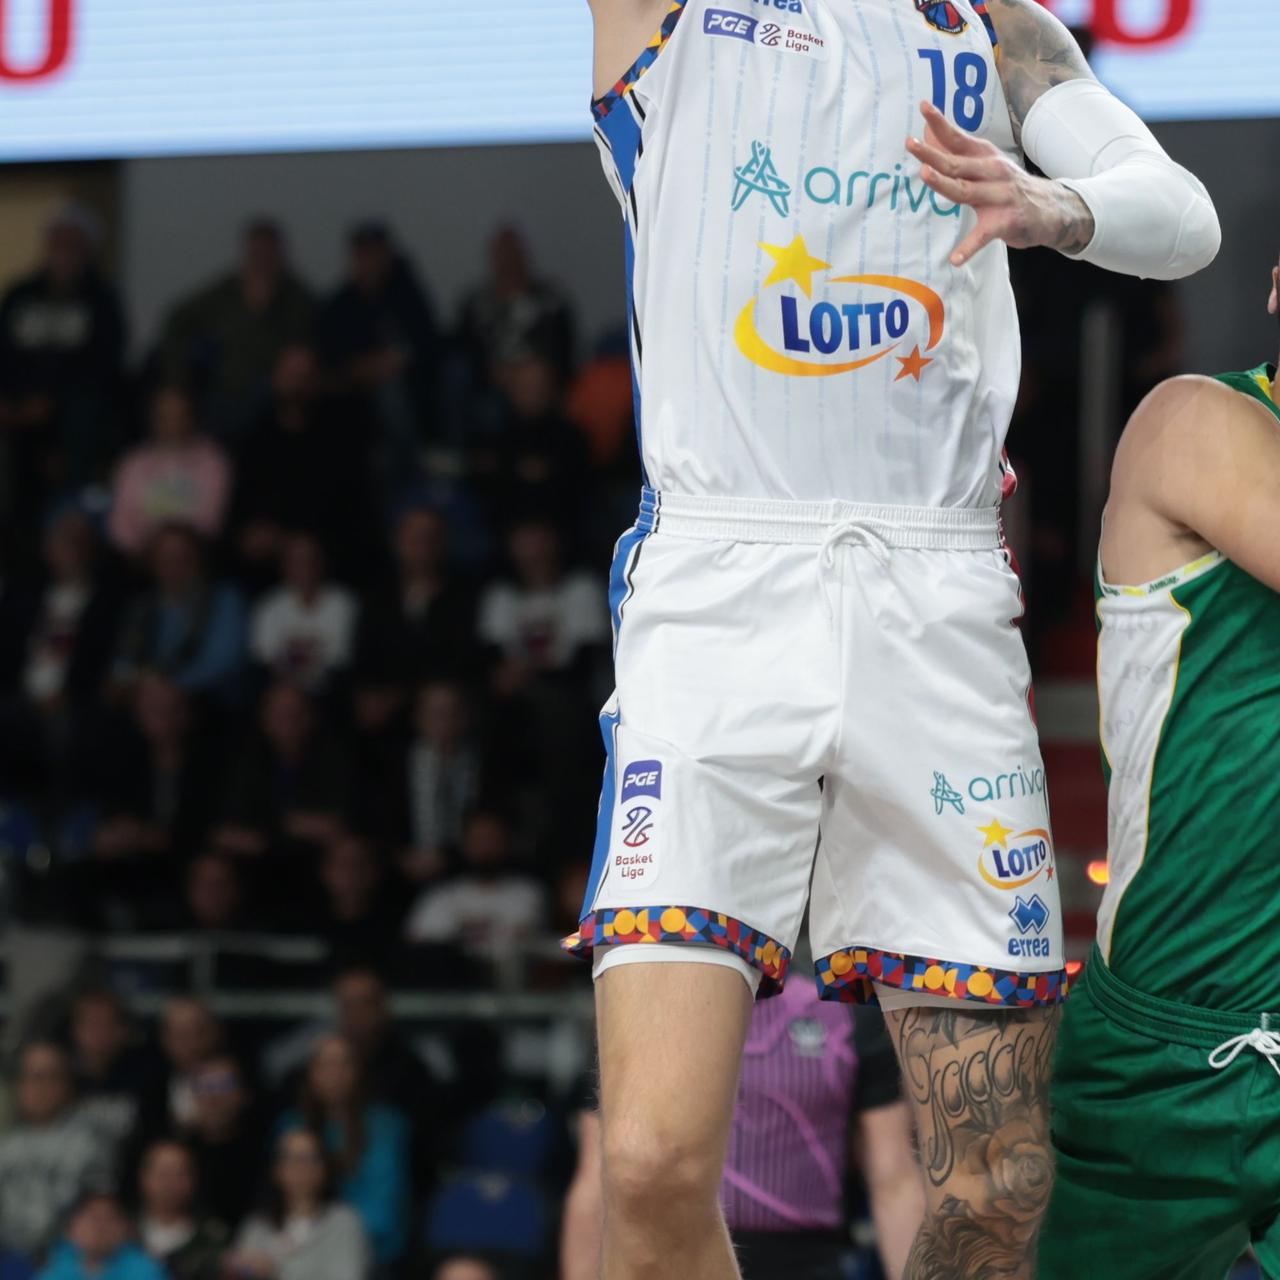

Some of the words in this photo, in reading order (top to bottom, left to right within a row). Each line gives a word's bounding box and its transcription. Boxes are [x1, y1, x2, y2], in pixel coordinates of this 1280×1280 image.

[707, 14, 751, 35] PGE
[785, 39, 810, 52] Liga
[787, 29, 824, 47] Basket
[918, 48, 988, 132] 18
[780, 295, 910, 355] LOTTO
[624, 771, 658, 788] PGE
[615, 854, 653, 866] Basket
[992, 839, 1047, 878] LOTTO
[622, 867, 644, 880] Liga
[1008, 937, 1050, 957] errea
